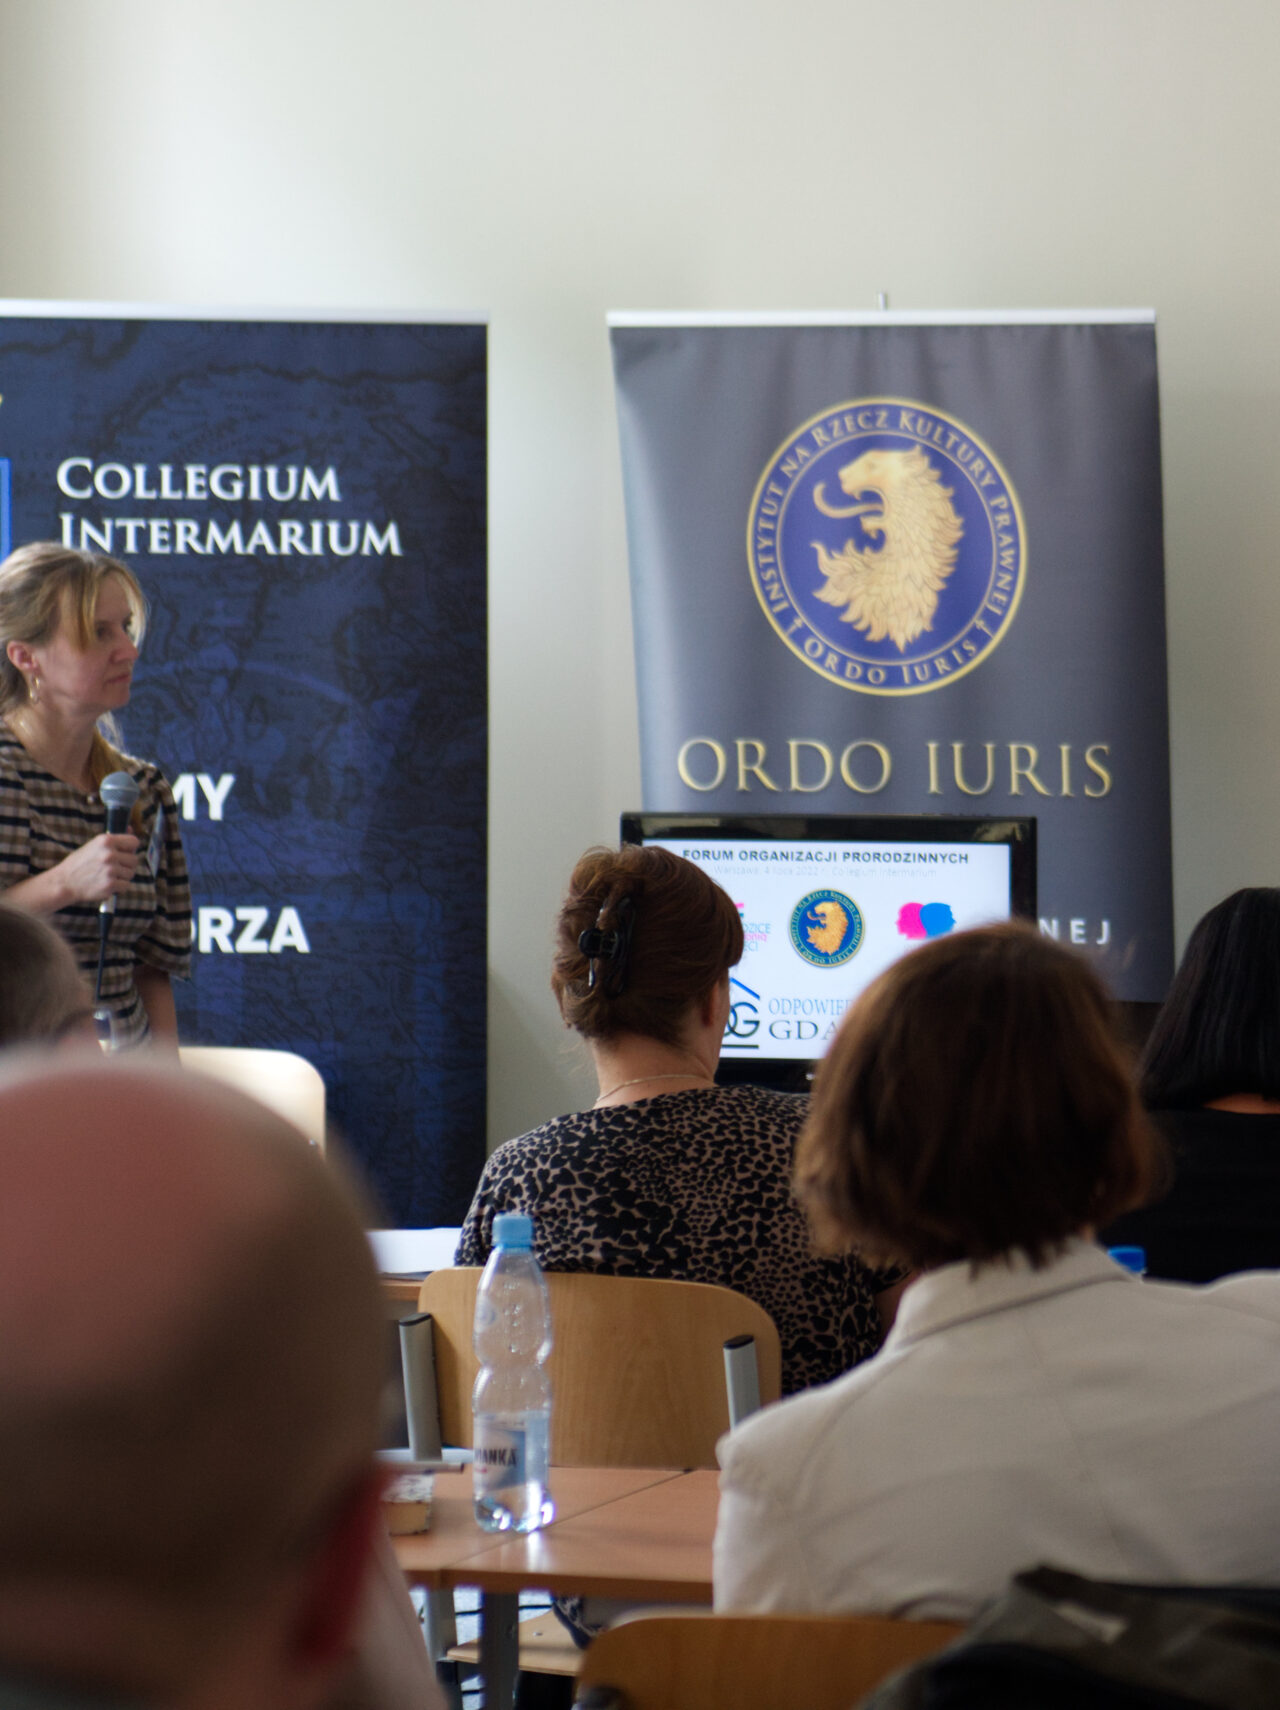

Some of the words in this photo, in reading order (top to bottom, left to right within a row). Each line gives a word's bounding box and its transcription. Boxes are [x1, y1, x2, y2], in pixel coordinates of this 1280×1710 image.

[56, 457, 342, 501] COLLEGIUM
[59, 512, 403, 556] INTERMARIUM
[757, 482, 789, 613] INSTYTUT
[780, 446, 810, 479] NA
[811, 410, 889, 447] RZECZ
[900, 410, 996, 488] KULTURY
[985, 496, 1015, 616] PRAWNEJ
[804, 637, 886, 684] ORDO
[902, 640, 976, 684] IURIS
[677, 738, 893, 794] ORDO
[926, 742, 1113, 797] IURIS
[682, 849, 734, 861] FORUM
[738, 850, 837, 863] ORGANIZACJI
[842, 852, 969, 864] PRORODZINNYCH
[190, 906, 311, 954] RZA
[1038, 918, 1111, 945] NEJ
